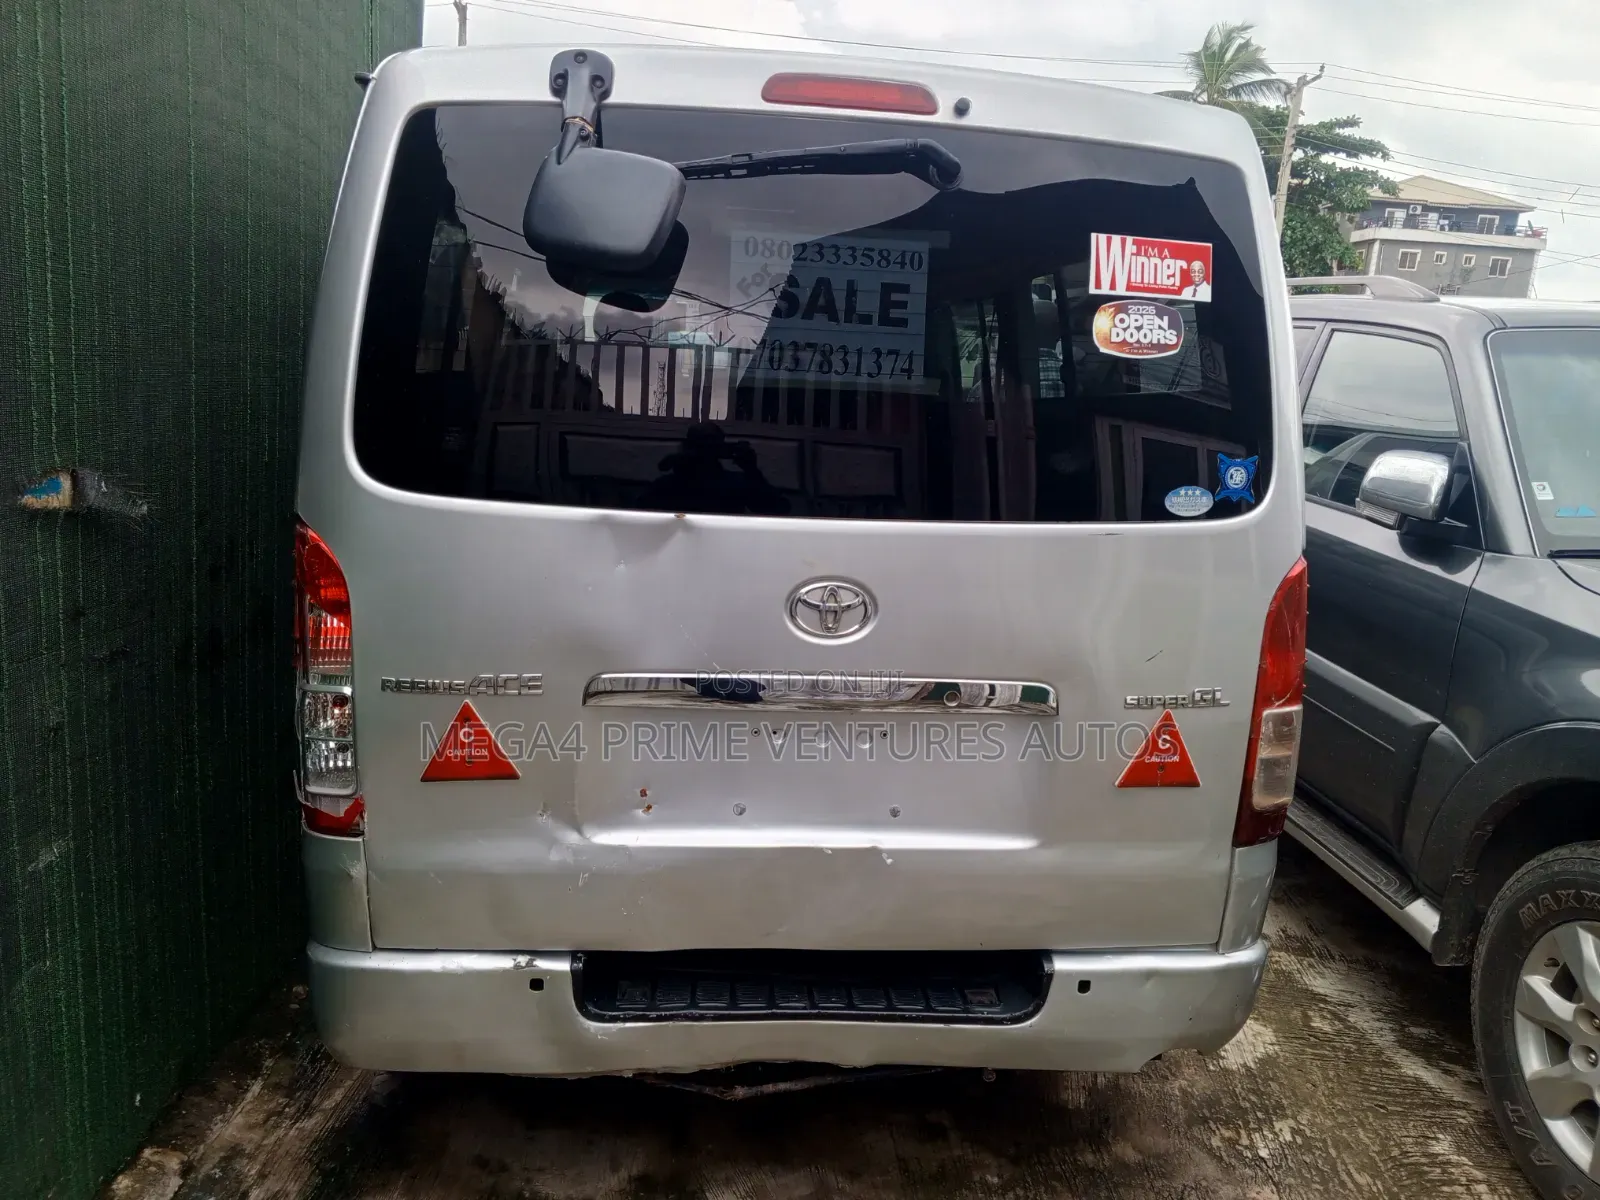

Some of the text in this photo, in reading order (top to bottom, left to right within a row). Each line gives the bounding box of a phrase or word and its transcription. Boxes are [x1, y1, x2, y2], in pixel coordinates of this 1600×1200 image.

[744, 236, 924, 271] 08023335840
[1141, 245, 1170, 258] I'M A
[1096, 233, 1187, 292] Winner
[768, 272, 911, 328] SALE
[1114, 313, 1169, 330] OPEN
[1110, 327, 1178, 345] DOORS
[446, 747, 489, 757] CAUTION
[1144, 755, 1180, 763] CAUTION
